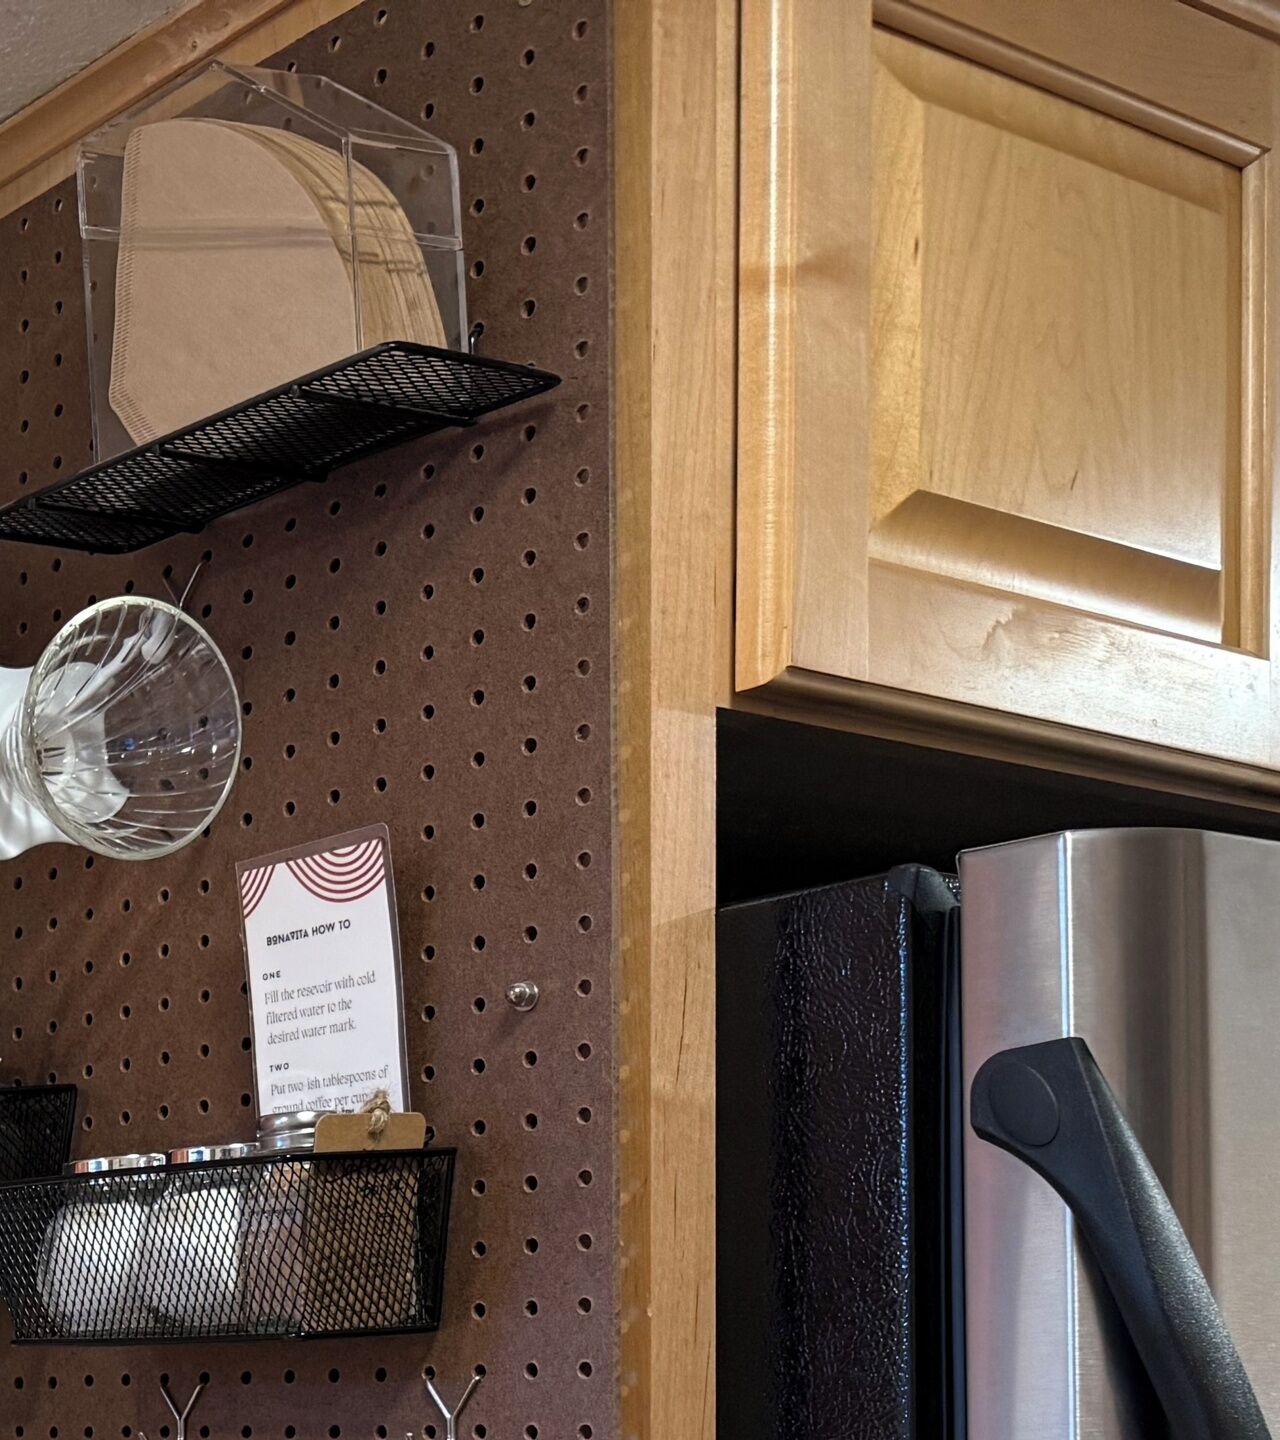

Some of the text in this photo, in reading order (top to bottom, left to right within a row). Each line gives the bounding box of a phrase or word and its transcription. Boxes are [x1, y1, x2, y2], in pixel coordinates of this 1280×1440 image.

[312, 922, 336, 936] HOW
[338, 919, 351, 931] TO
[262, 970, 281, 981] ONE
[264, 970, 376, 1005] Fill the resevoir with cold
[266, 998, 352, 1025] filtered water to the
[267, 1018, 357, 1045] desired water mark.
[269, 1062, 290, 1073] TWO
[270, 1083, 286, 1096] Put
[322, 1069, 377, 1089] tablespoons
[378, 1065, 389, 1079] of
[305, 1097, 332, 1111] coffee
[334, 1095, 349, 1110] per
